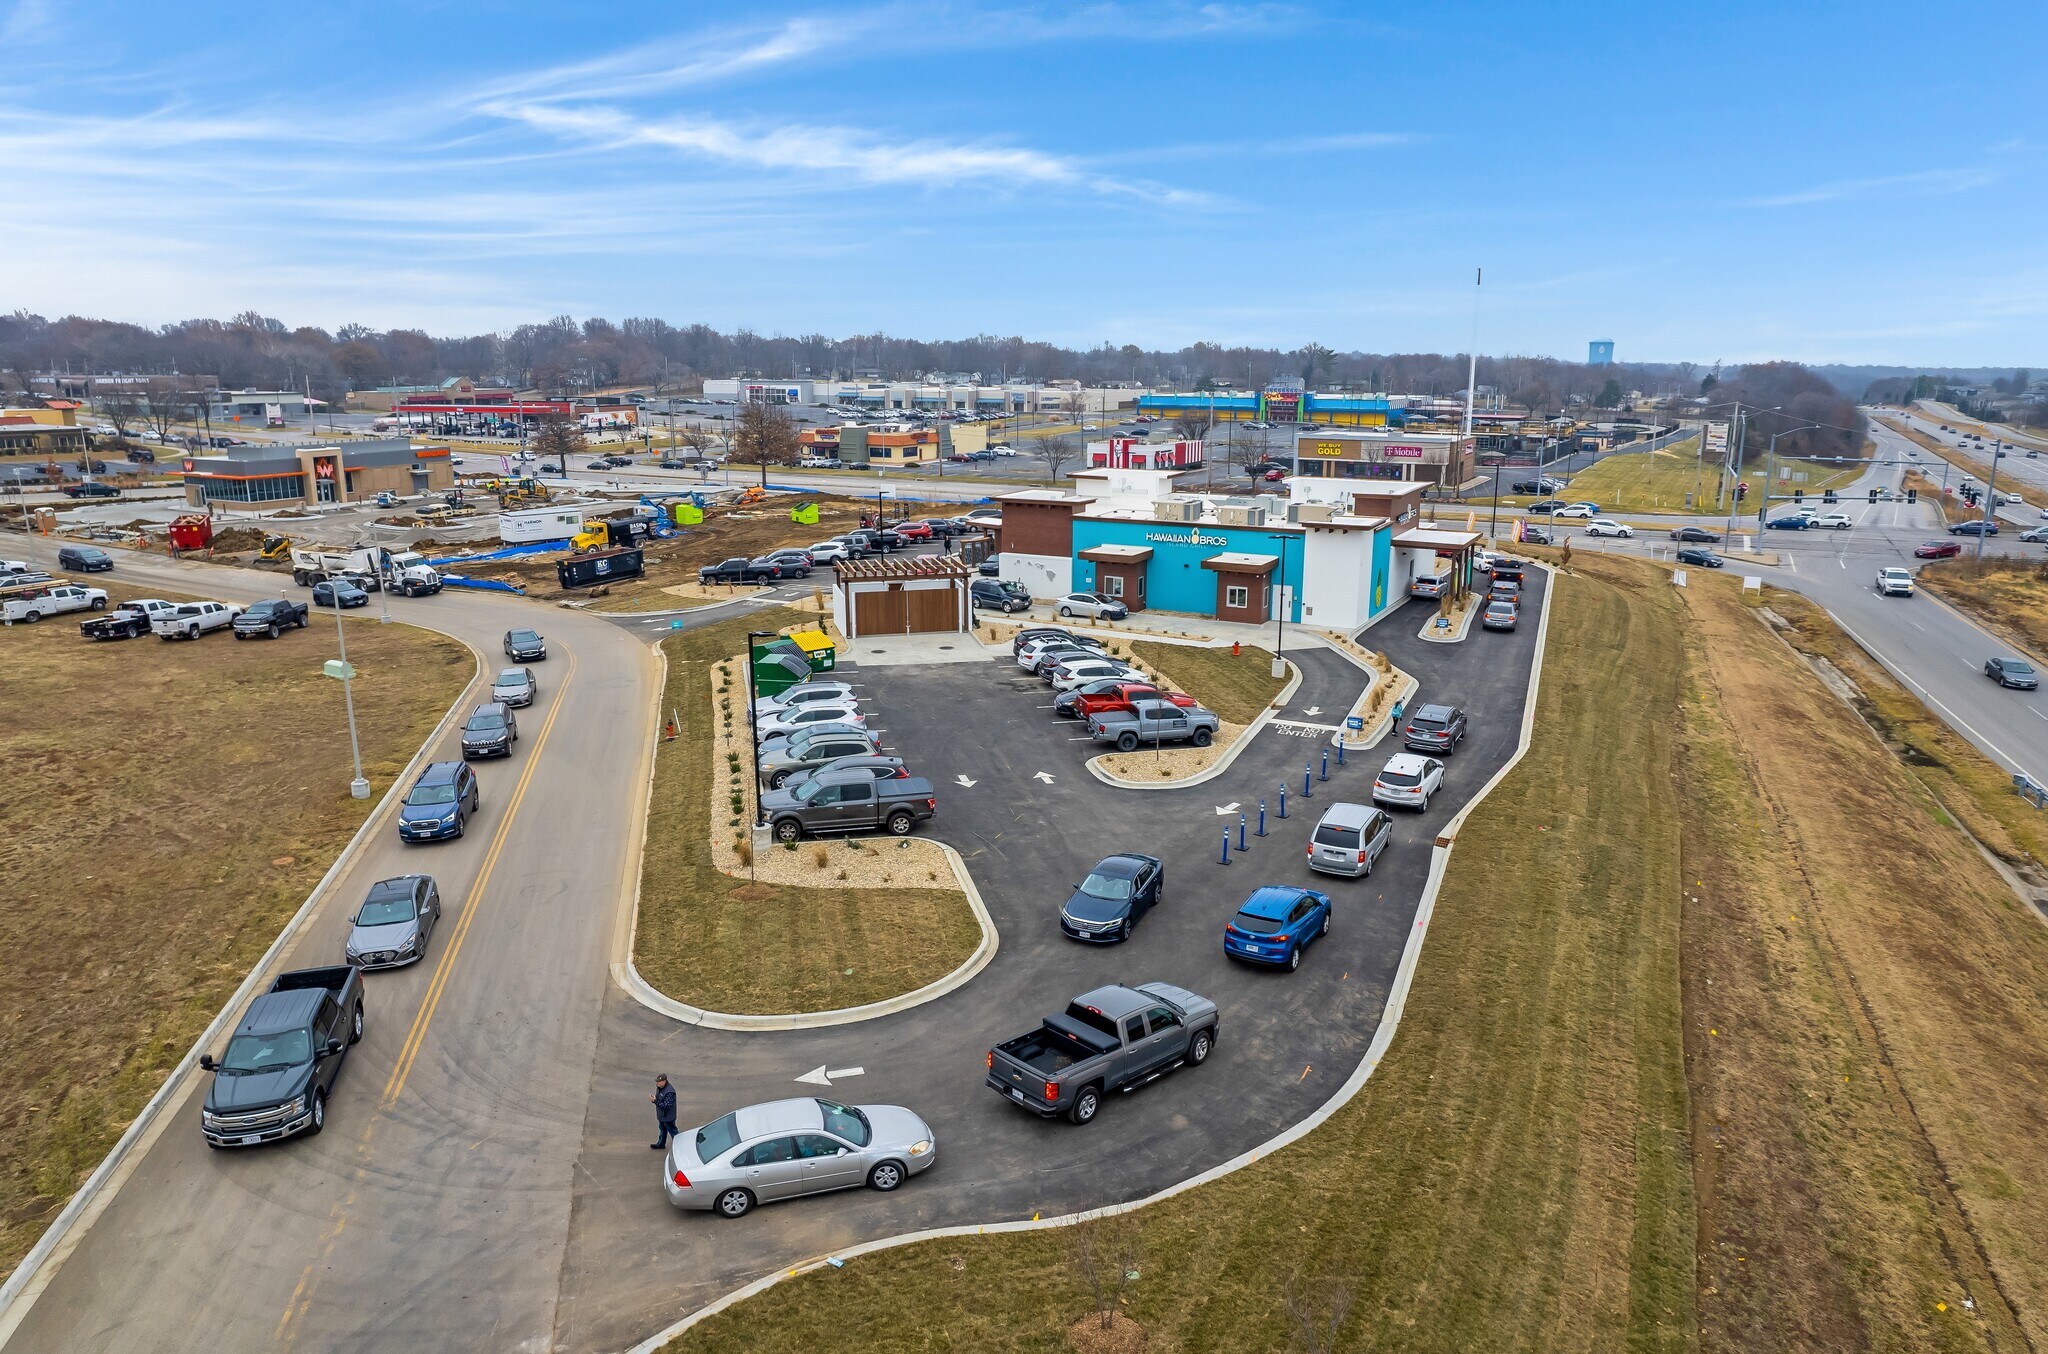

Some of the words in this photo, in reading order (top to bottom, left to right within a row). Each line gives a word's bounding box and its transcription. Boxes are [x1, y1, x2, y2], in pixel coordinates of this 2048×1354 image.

[1317, 447, 1341, 456] GOLD
[1146, 532, 1191, 543] HAWAIIAN
[1200, 536, 1227, 546] BROS
[597, 559, 608, 568] KC
[1277, 729, 1318, 738] ENTER
